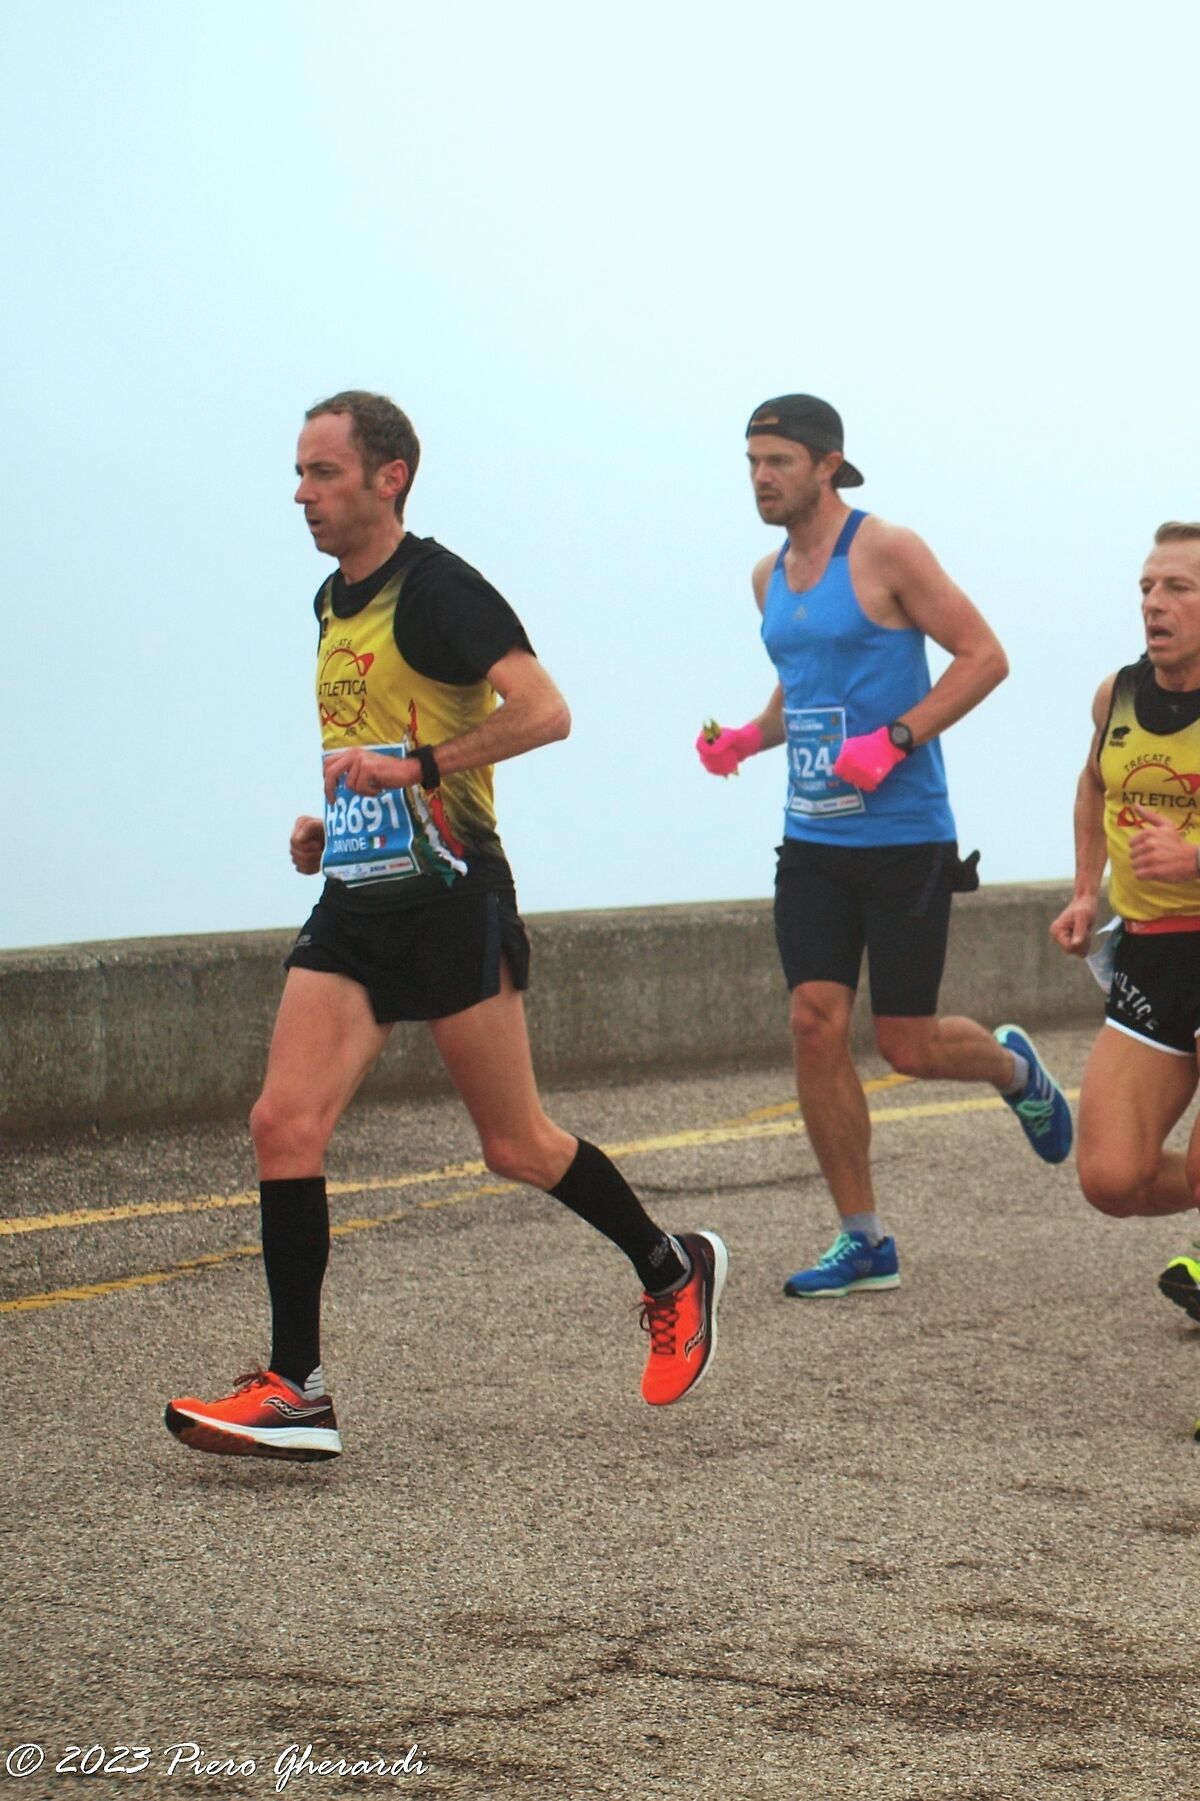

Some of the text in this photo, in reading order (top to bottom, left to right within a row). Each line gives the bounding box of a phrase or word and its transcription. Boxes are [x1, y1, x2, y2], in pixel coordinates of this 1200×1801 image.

[1124, 753, 1172, 773] TRECATE
[1121, 791, 1198, 808] ATLETICA
[326, 792, 401, 837] H3691
